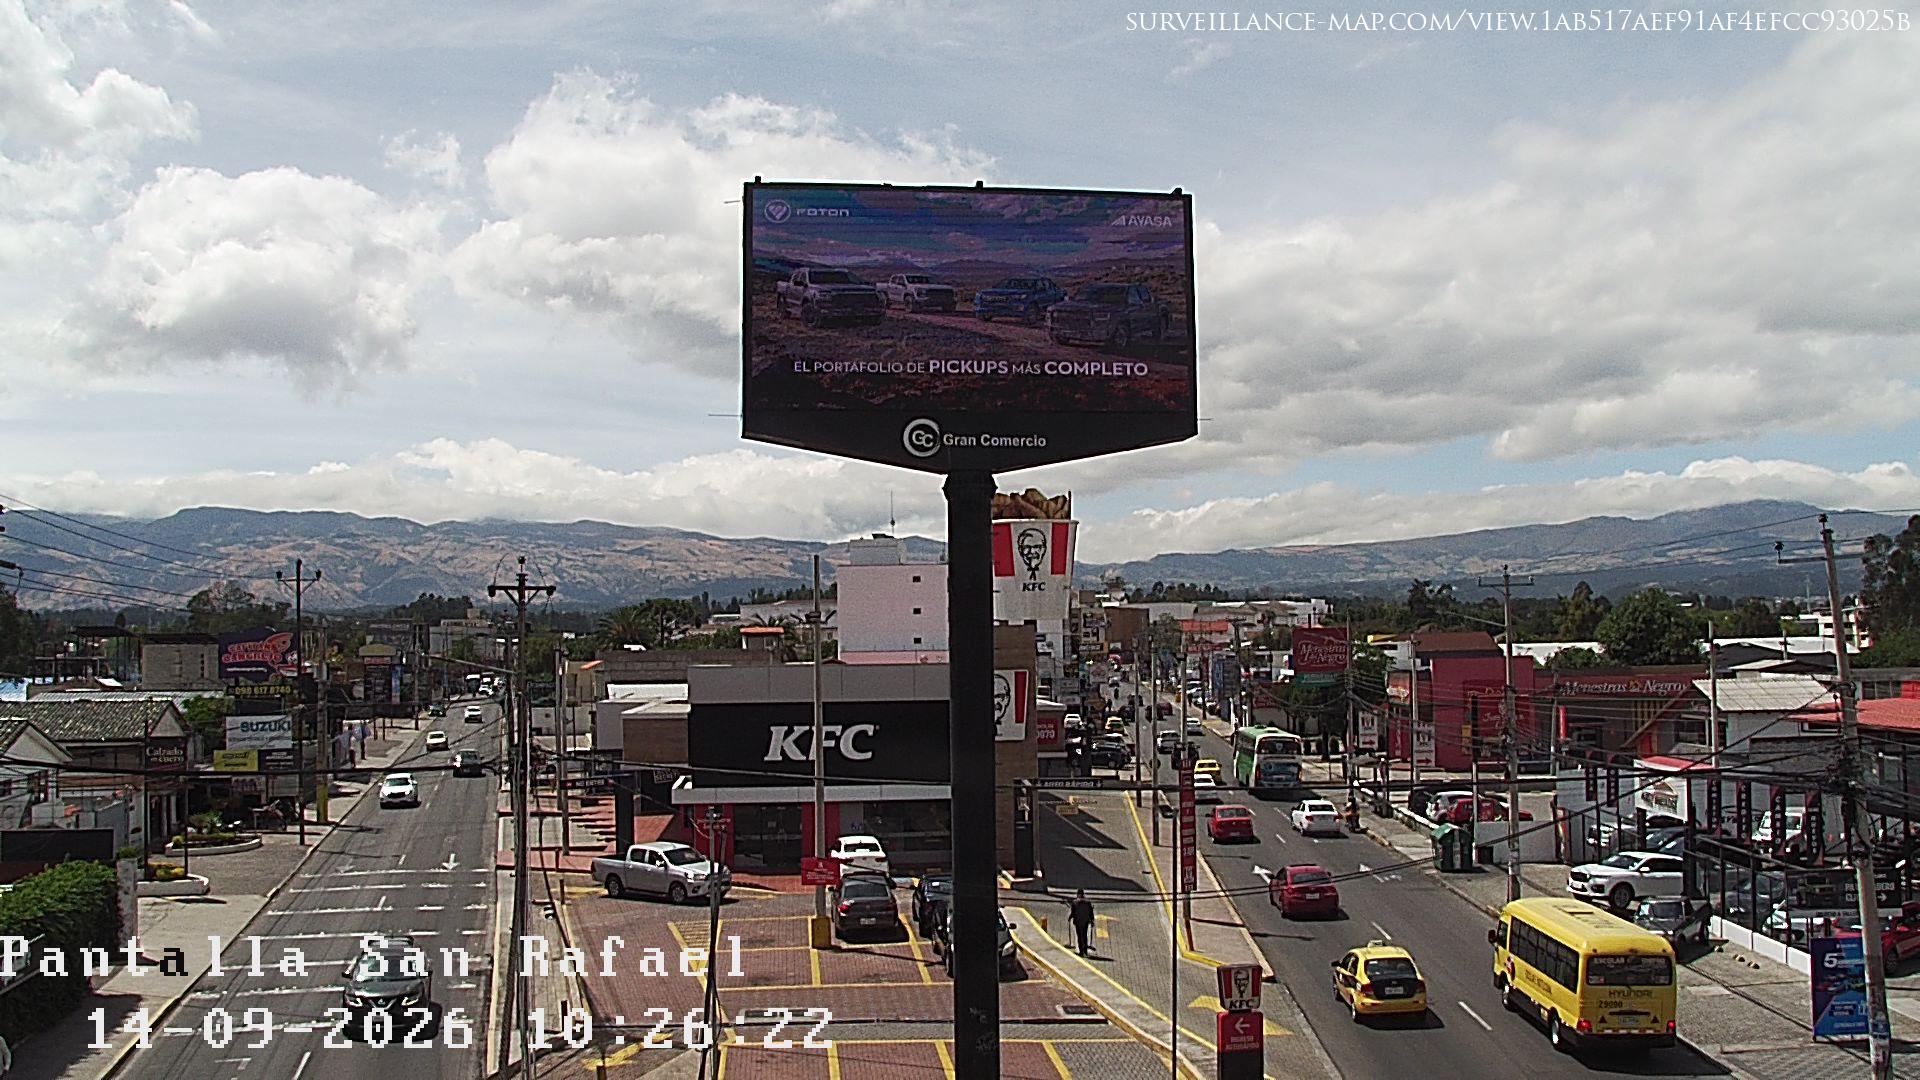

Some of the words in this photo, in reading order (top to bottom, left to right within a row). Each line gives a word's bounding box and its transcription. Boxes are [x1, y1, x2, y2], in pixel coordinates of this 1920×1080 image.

[1128, 215, 1172, 227] AYASA
[794, 361, 810, 373] EL
[814, 361, 902, 373] PORTAFOLIO
[907, 362, 925, 373] DE
[929, 360, 1008, 374] PICKUPS
[1012, 361, 1041, 375] MÁS
[1044, 361, 1149, 376] COMPLETO
[943, 433, 977, 446] Gran
[980, 434, 1047, 447] Comercio
[1022, 582, 1047, 592] KFC
[1560, 681, 1627, 696] Menestras
[240, 721, 291, 733] SUZUKI
[764, 724, 874, 760] KFC
[146, 746, 183, 757] Calzado
[1823, 953, 1838, 967] 5
[1229, 1000, 1254, 1009] KFC
